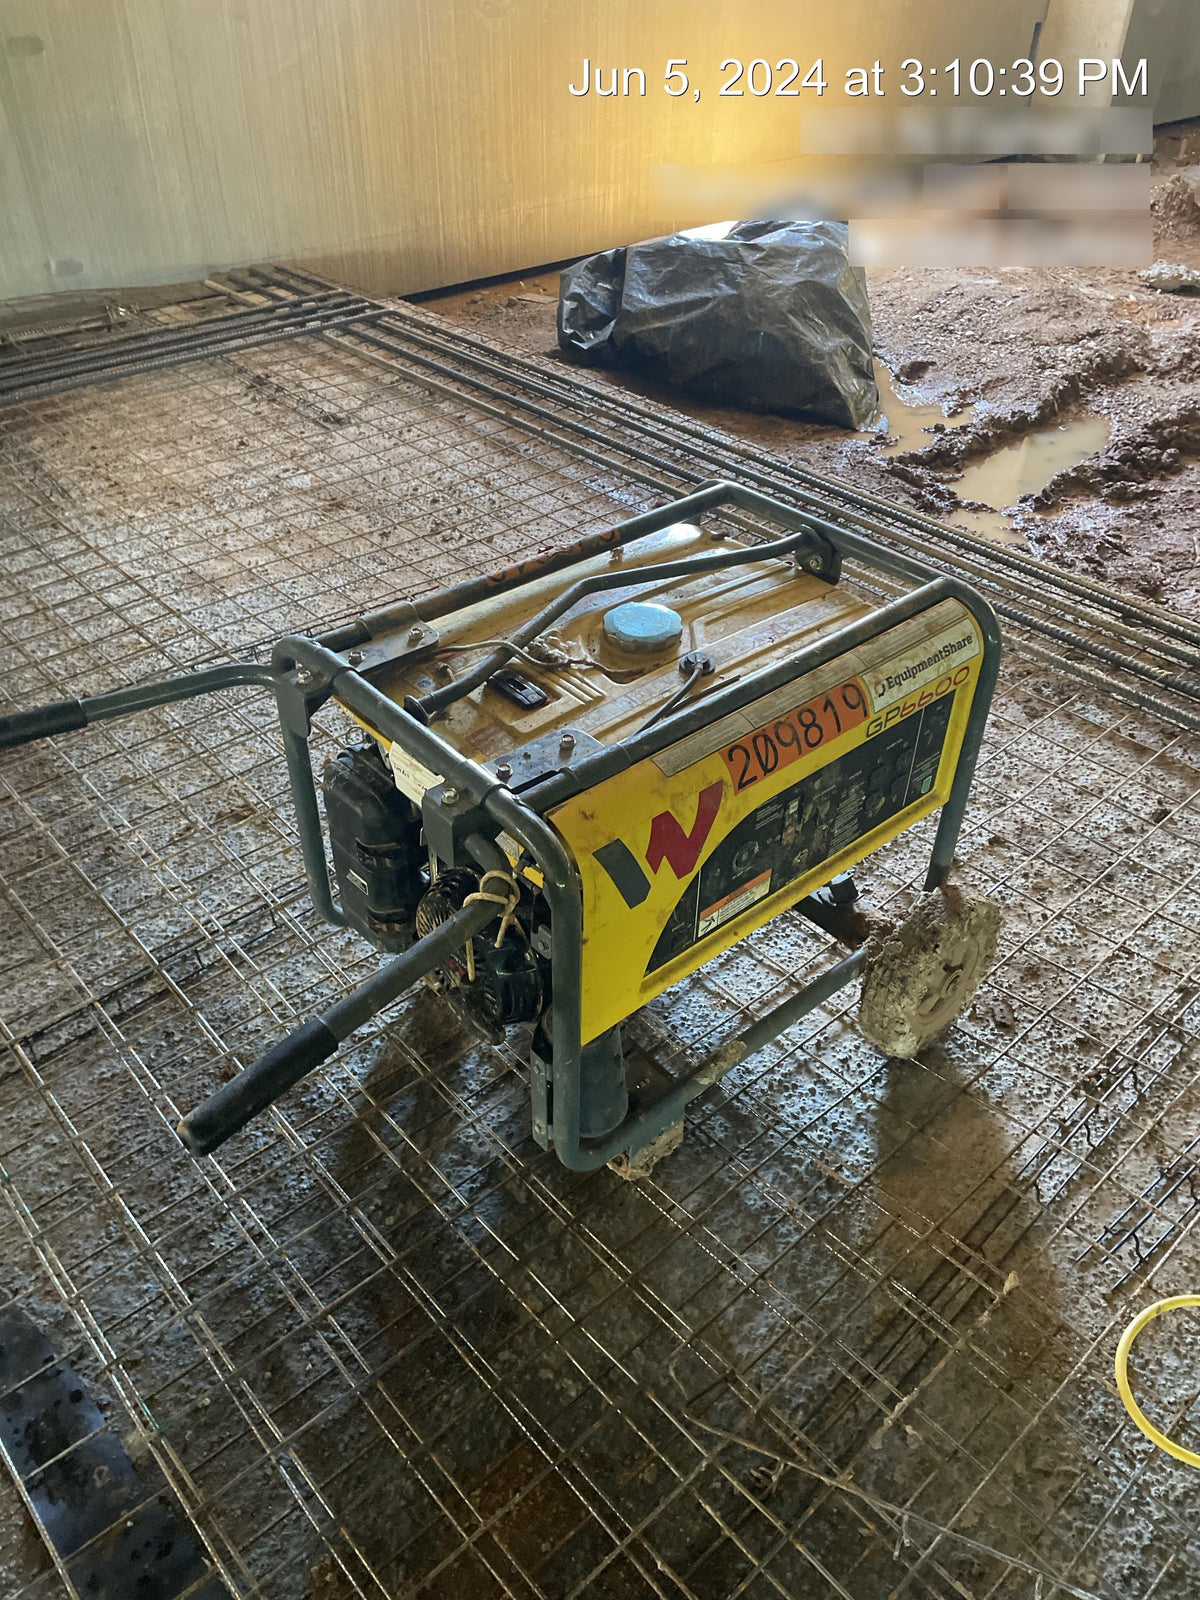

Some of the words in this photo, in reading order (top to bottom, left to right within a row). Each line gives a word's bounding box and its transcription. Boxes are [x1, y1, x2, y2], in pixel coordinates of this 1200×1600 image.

[885, 634, 973, 690] EquipmentShare
[727, 682, 869, 790] 209819
[866, 666, 970, 738] GP6600
